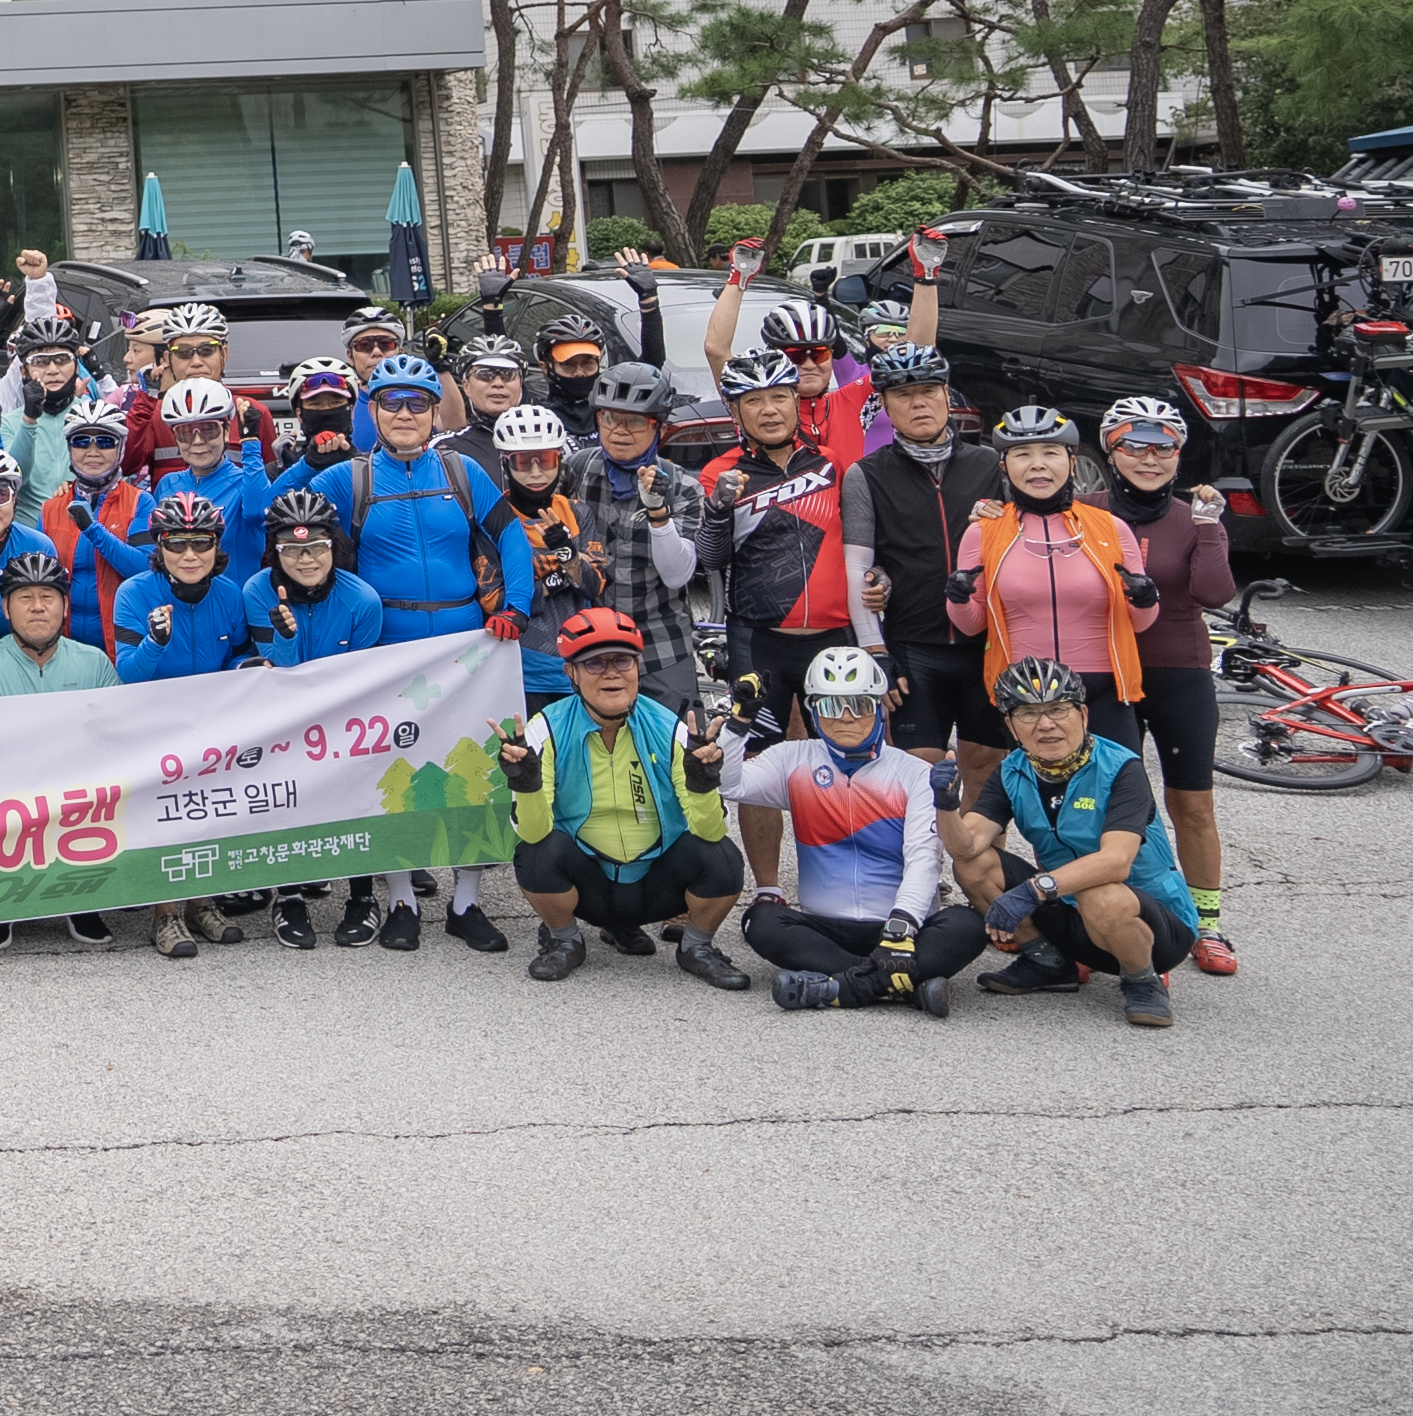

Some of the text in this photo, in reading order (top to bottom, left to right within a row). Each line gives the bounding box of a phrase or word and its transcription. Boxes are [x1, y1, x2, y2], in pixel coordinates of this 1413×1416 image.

[156, 779, 299, 824] 고창군 일대
[243, 831, 372, 865] 고창문화관광재단
